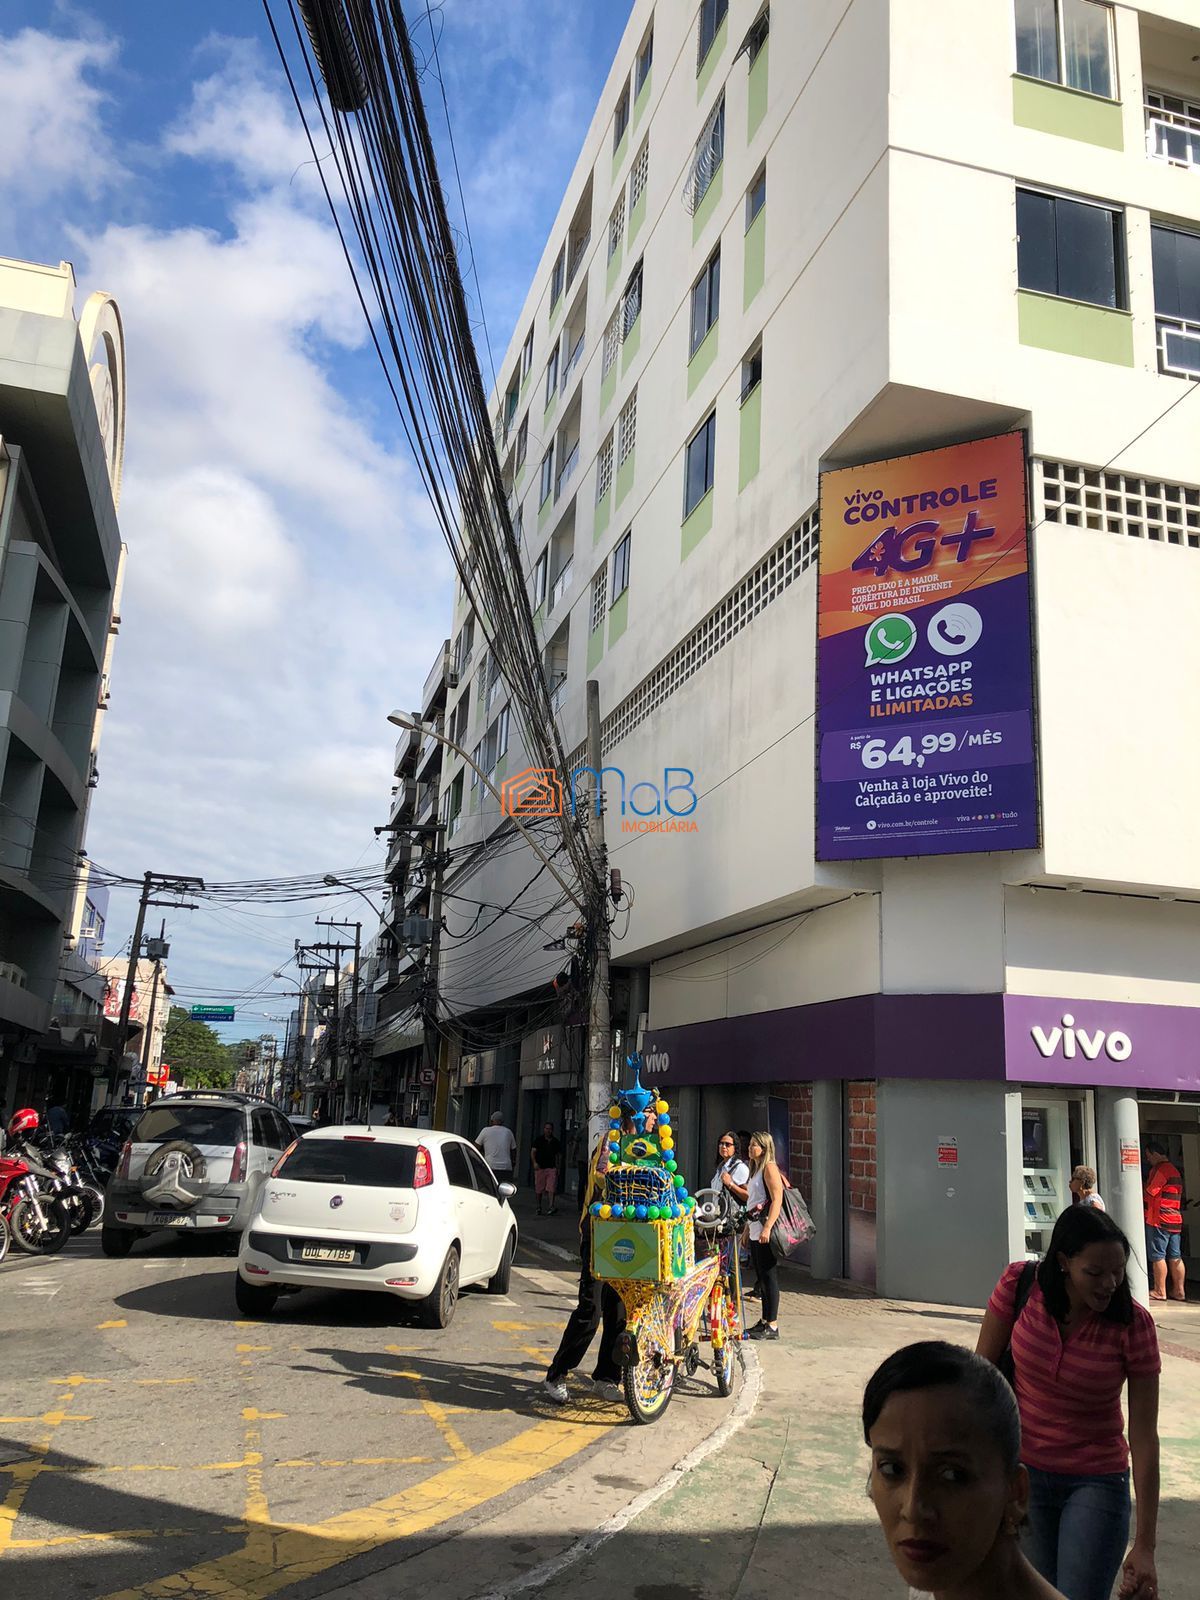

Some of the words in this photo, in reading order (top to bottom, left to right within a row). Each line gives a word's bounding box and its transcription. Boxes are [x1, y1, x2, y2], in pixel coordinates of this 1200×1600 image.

[844, 489, 884, 505] vivo
[844, 478, 998, 525] CONTROLE
[851, 590, 899, 604] COBERTURA
[900, 588, 911, 596] DE
[912, 580, 953, 593] INTERNET
[852, 585, 877, 595] PREÇO
[878, 581, 897, 591] FIXO
[904, 578, 910, 587] A
[911, 573, 939, 585] MAIOR
[851, 603, 879, 613] MÓVEL
[880, 600, 892, 608] DO
[893, 595, 925, 607] BRASIL.
[870, 661, 973, 686] WHATSAPP
[871, 689, 882, 702] E
[886, 677, 973, 701] LIGAÇÕES
[870, 693, 974, 718] ILIMITADAS
[850, 741, 862, 750] R$
[859, 778, 899, 793] Venha
[902, 777, 909, 789] à
[912, 776, 937, 791] loja
[939, 773, 969, 786] Vivo
[971, 771, 988, 783] do
[855, 792, 911, 809] Calçadão
[914, 793, 921, 802] e
[924, 784, 993, 803] aproveite!
[1002, 811, 1018, 819] tudo
[1031, 1013, 1132, 1062] vivo
[645, 1044, 669, 1073] vivo
